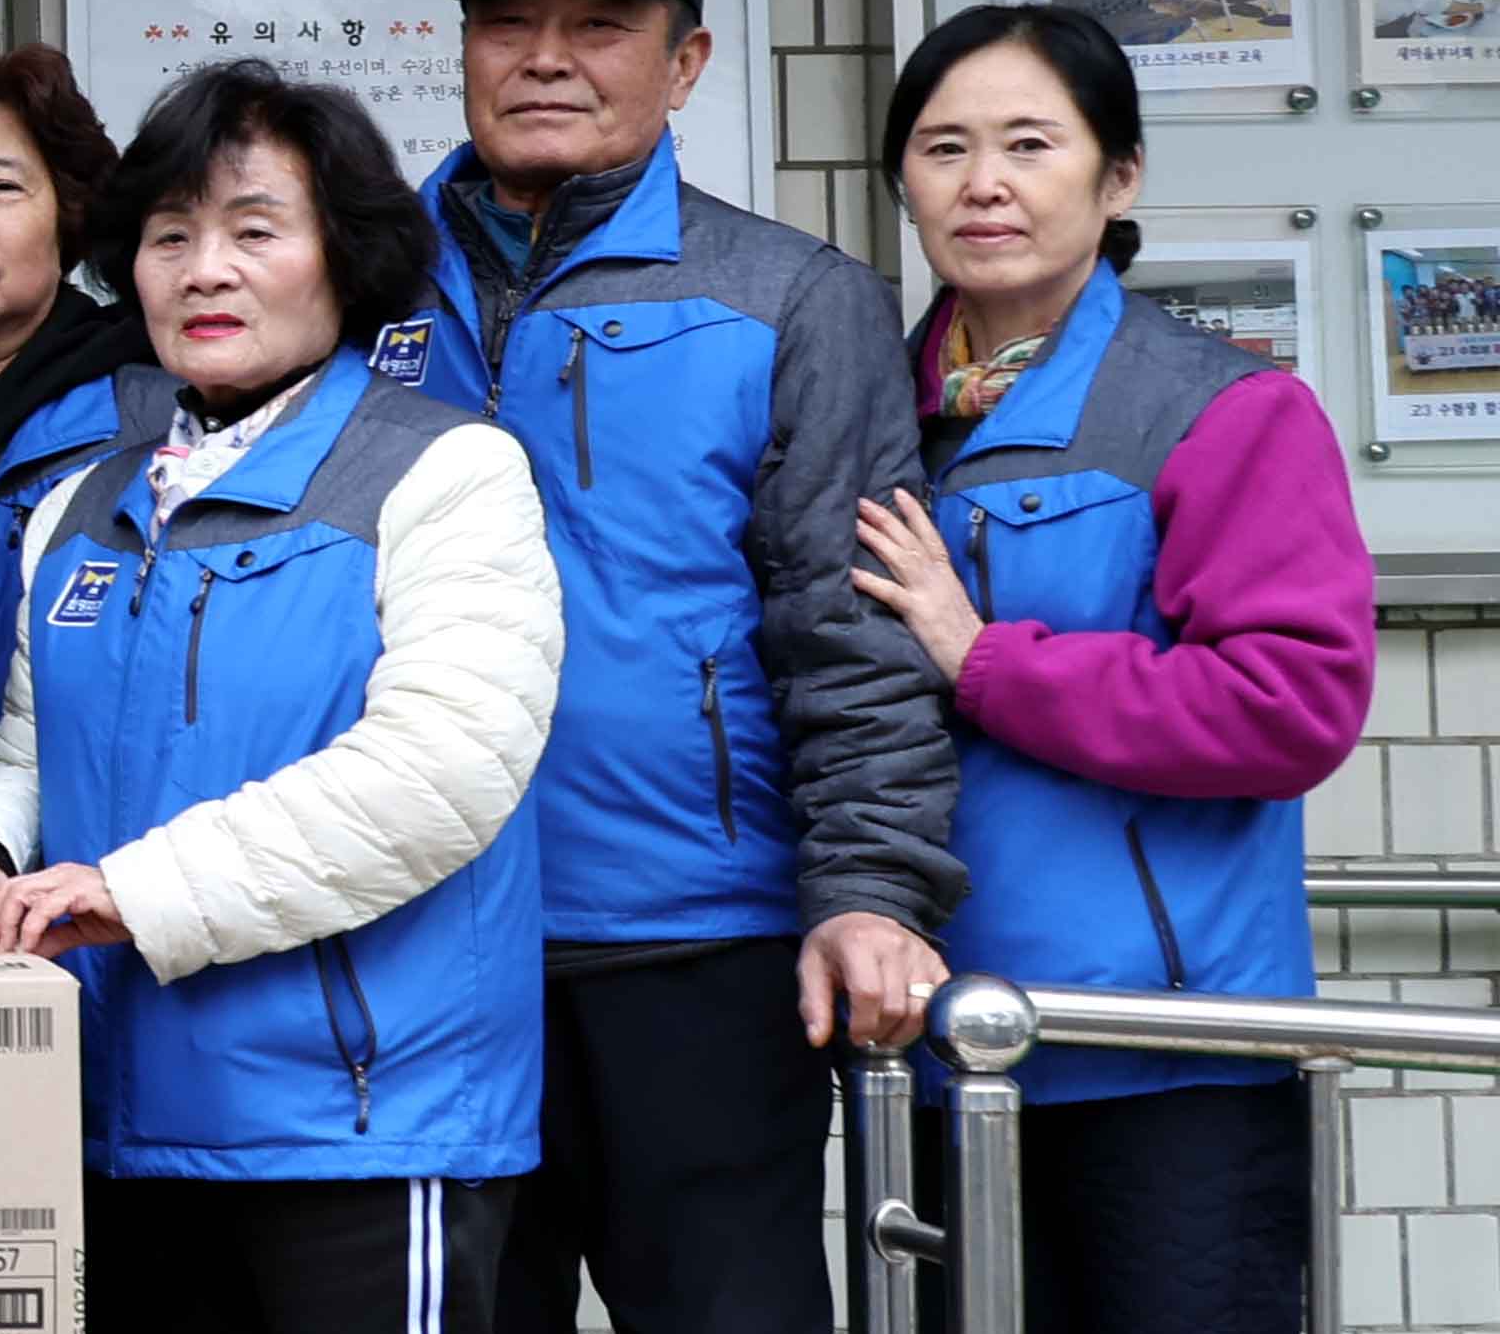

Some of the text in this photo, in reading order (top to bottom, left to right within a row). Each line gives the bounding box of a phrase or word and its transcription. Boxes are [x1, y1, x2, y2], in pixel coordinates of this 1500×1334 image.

[208, 18, 367, 48] 유 의 사 항
